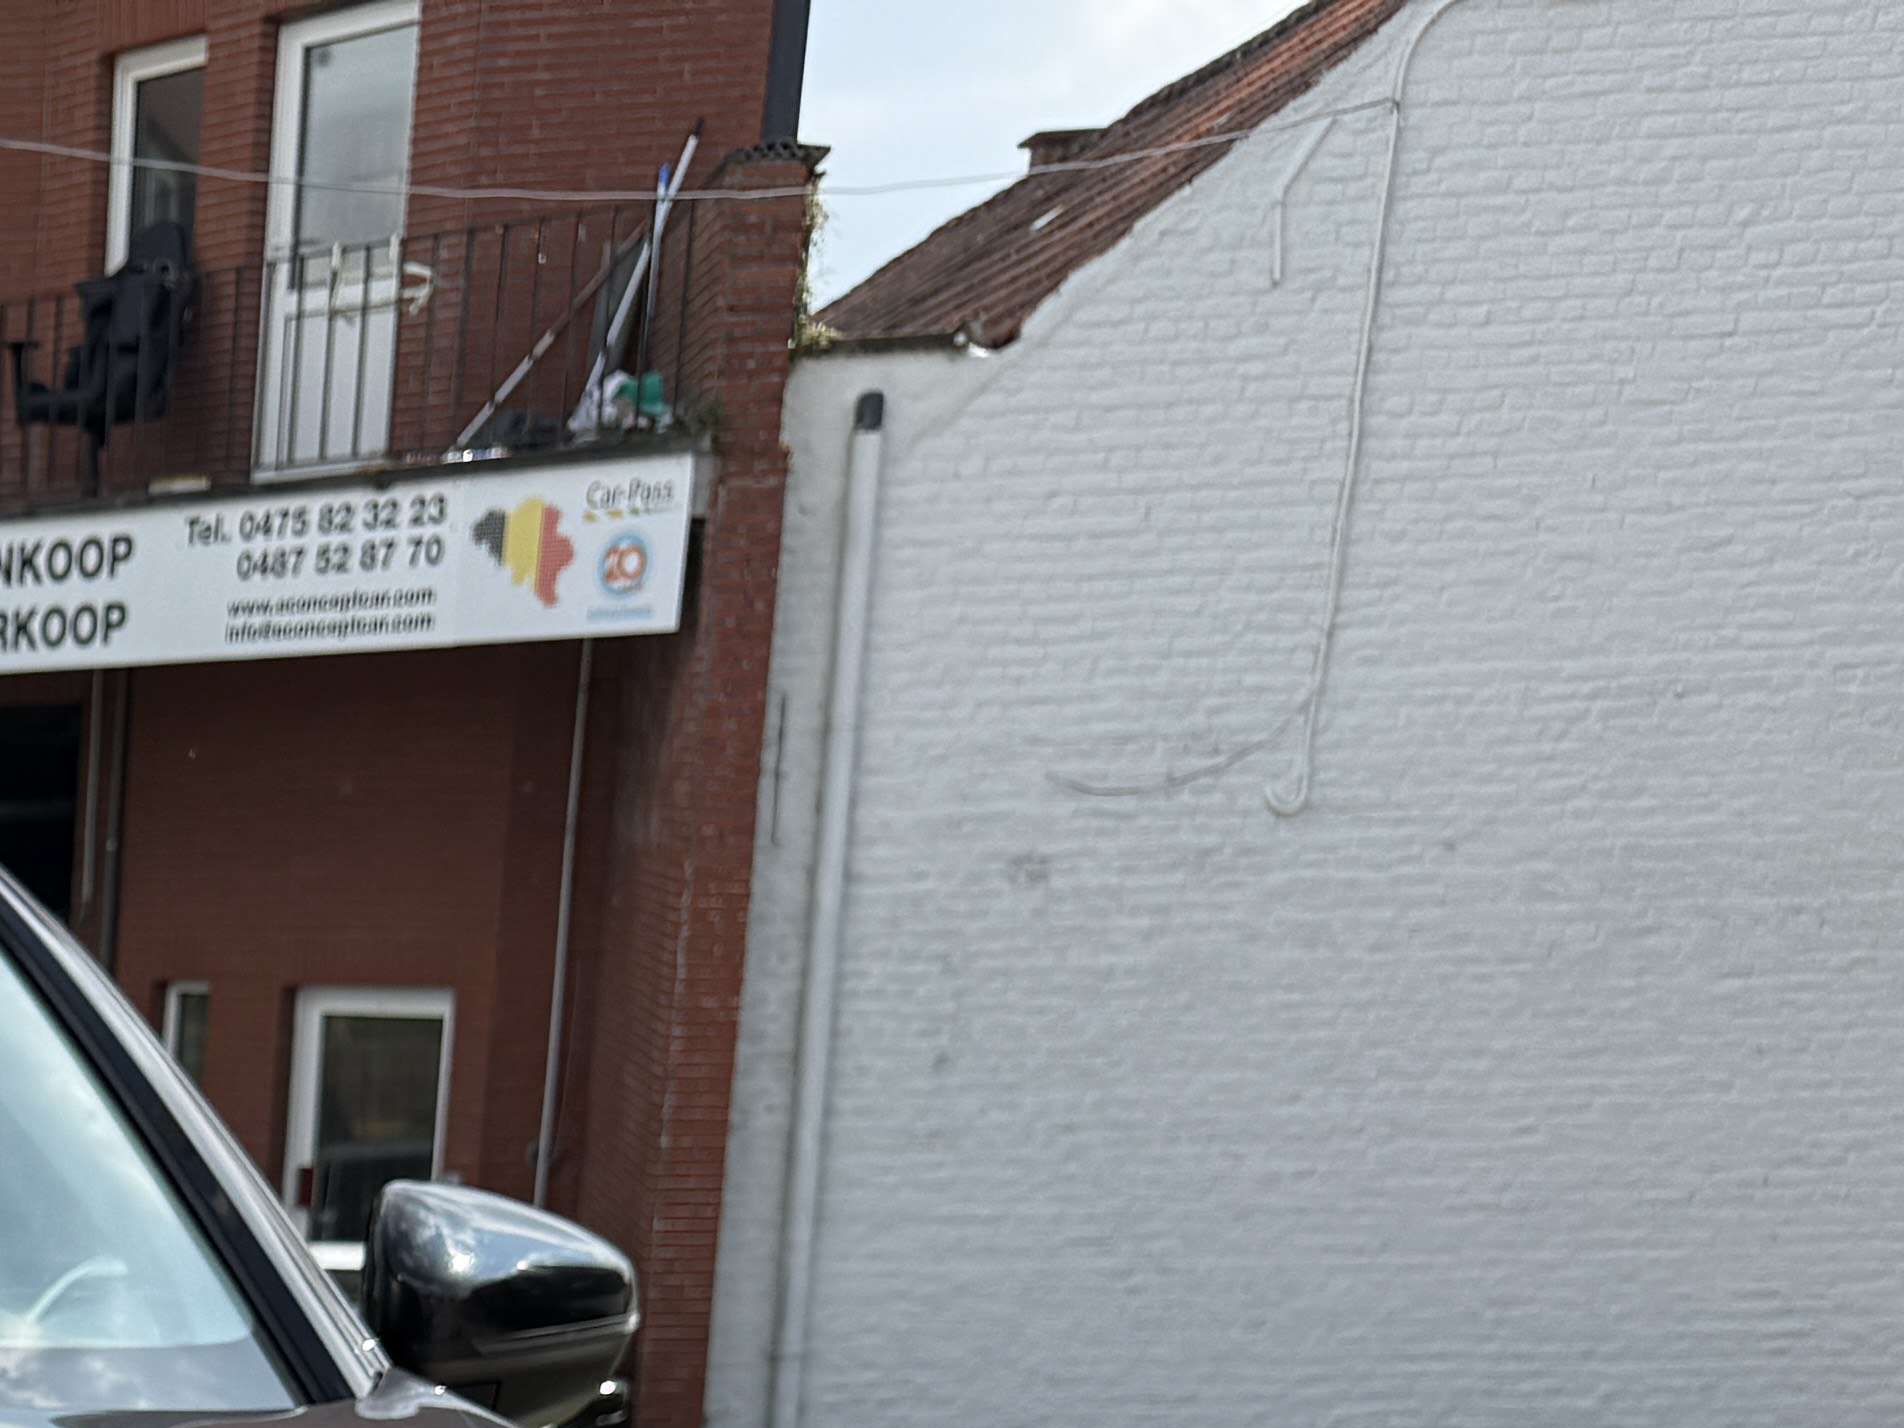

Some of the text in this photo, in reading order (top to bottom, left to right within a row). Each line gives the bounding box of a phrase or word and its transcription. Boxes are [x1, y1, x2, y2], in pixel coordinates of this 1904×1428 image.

[186, 493, 448, 547] Tel. 0475 82 32 23
[236, 545, 304, 581] 0487
[358, 537, 395, 572] 87
[408, 533, 446, 568] 70
